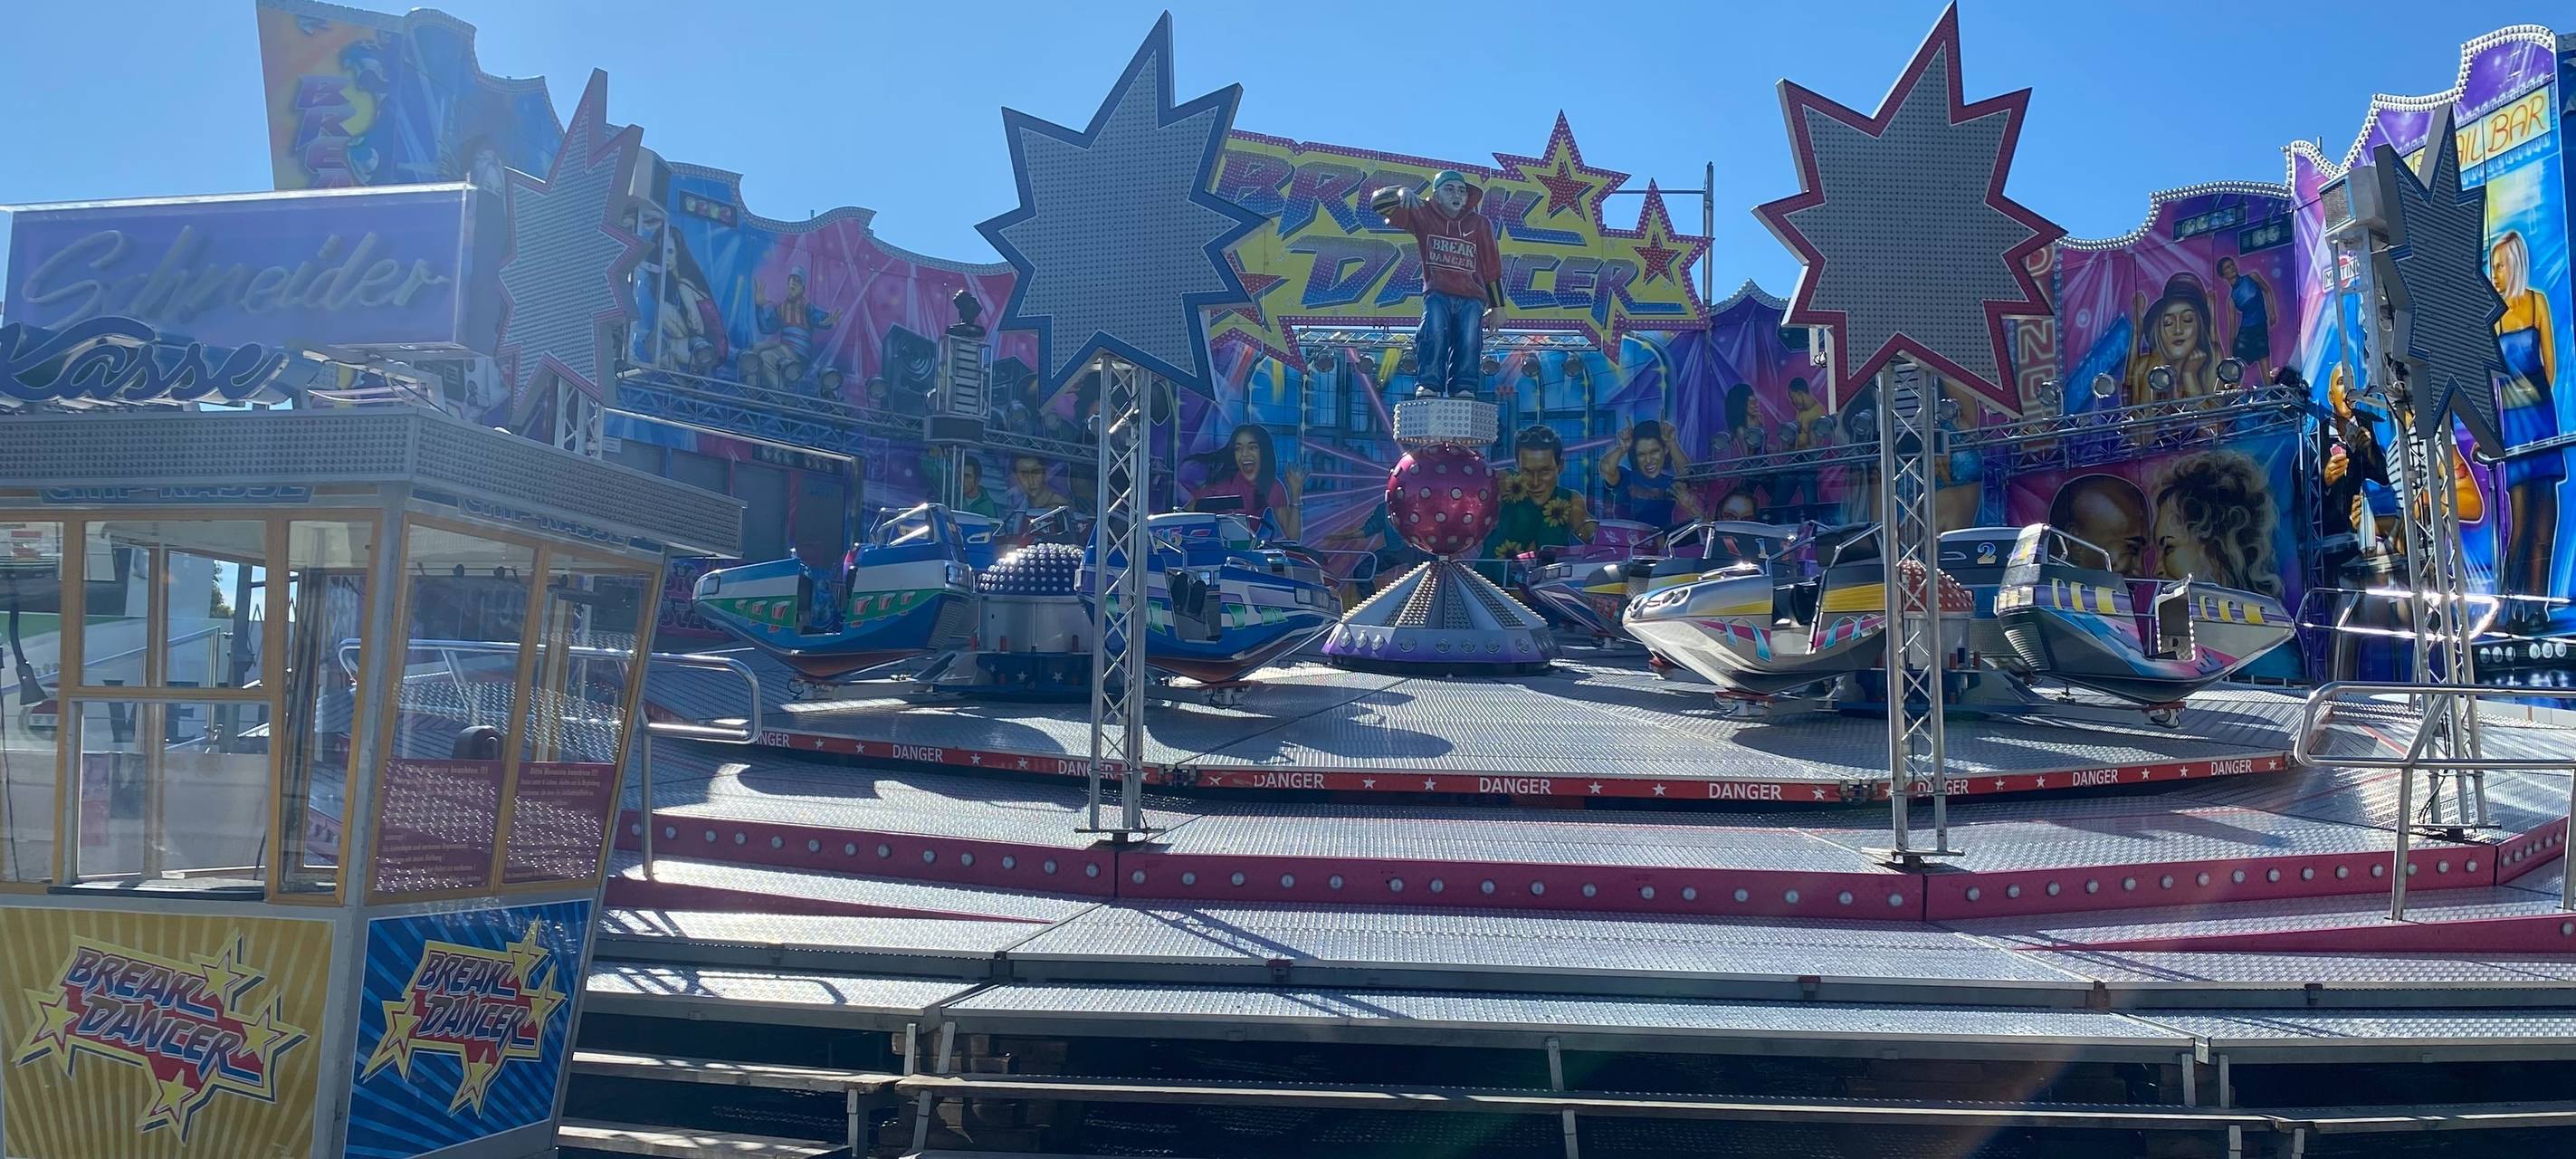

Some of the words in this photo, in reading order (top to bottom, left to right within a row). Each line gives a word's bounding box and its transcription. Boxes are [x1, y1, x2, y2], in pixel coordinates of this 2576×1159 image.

[2487, 95, 2546, 153] BAR
[1214, 149, 1587, 246] BREK
[1432, 238, 1475, 258] BREAK
[1428, 251, 1475, 269] DANCER
[23, 223, 449, 331] Schneider
[1285, 234, 1688, 330] DACER
[0, 316, 290, 404] Kasse
[1977, 541, 1997, 565] 2
[754, 731, 790, 748] NGER
[892, 743, 944, 763] DANGER
[2072, 768, 2119, 787] DANGER
[2210, 758, 2253, 777] DANGER
[1254, 771, 1325, 790] DANGER
[1478, 777, 1552, 795] DANGER
[1708, 782, 1783, 800] DANGER
[1917, 779, 1970, 797] DAGER
[66, 948, 217, 1018] BREAK
[416, 952, 520, 998] BREAK
[420, 994, 536, 1047] DANCER
[78, 995, 261, 1083] DANCER
